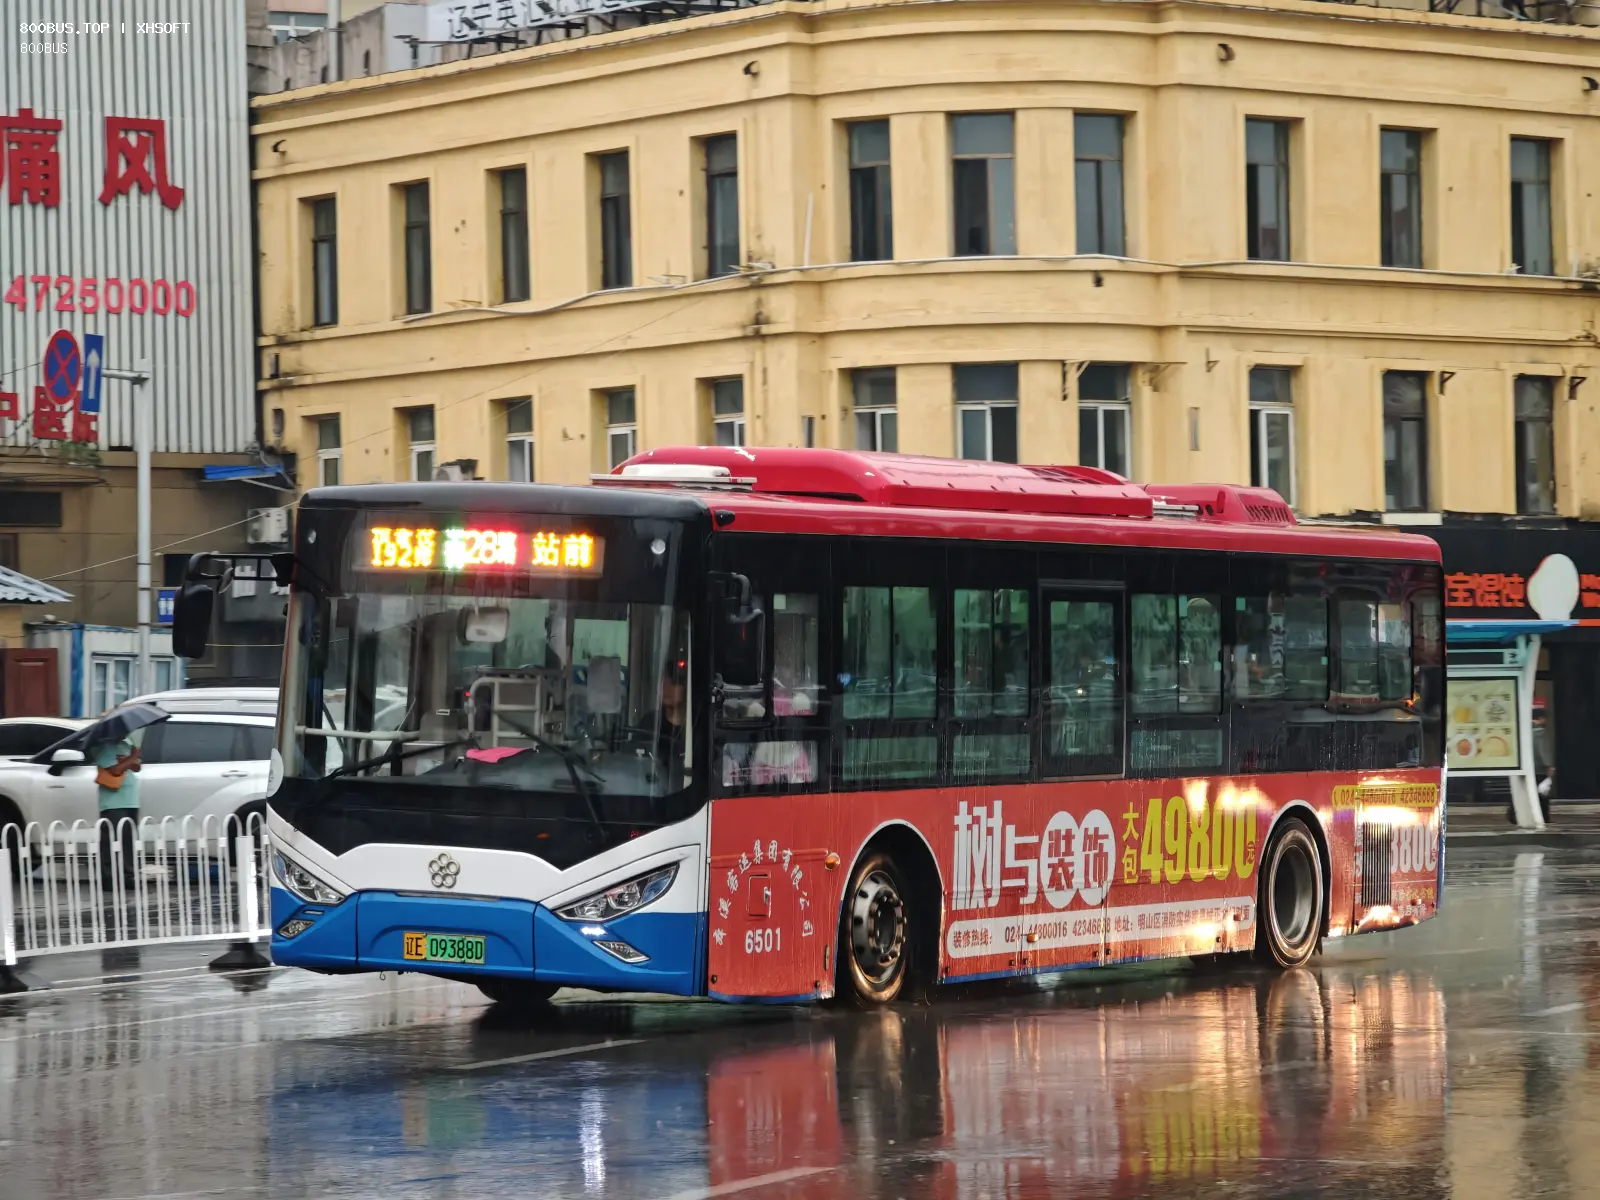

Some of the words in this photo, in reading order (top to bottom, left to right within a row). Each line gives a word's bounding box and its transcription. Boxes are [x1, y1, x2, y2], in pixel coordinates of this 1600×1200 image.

[5, 275, 196, 317] 47250000
[532, 531, 594, 568] 站前
[1122, 801, 1140, 884] 大包
[745, 927, 781, 954] 6501
